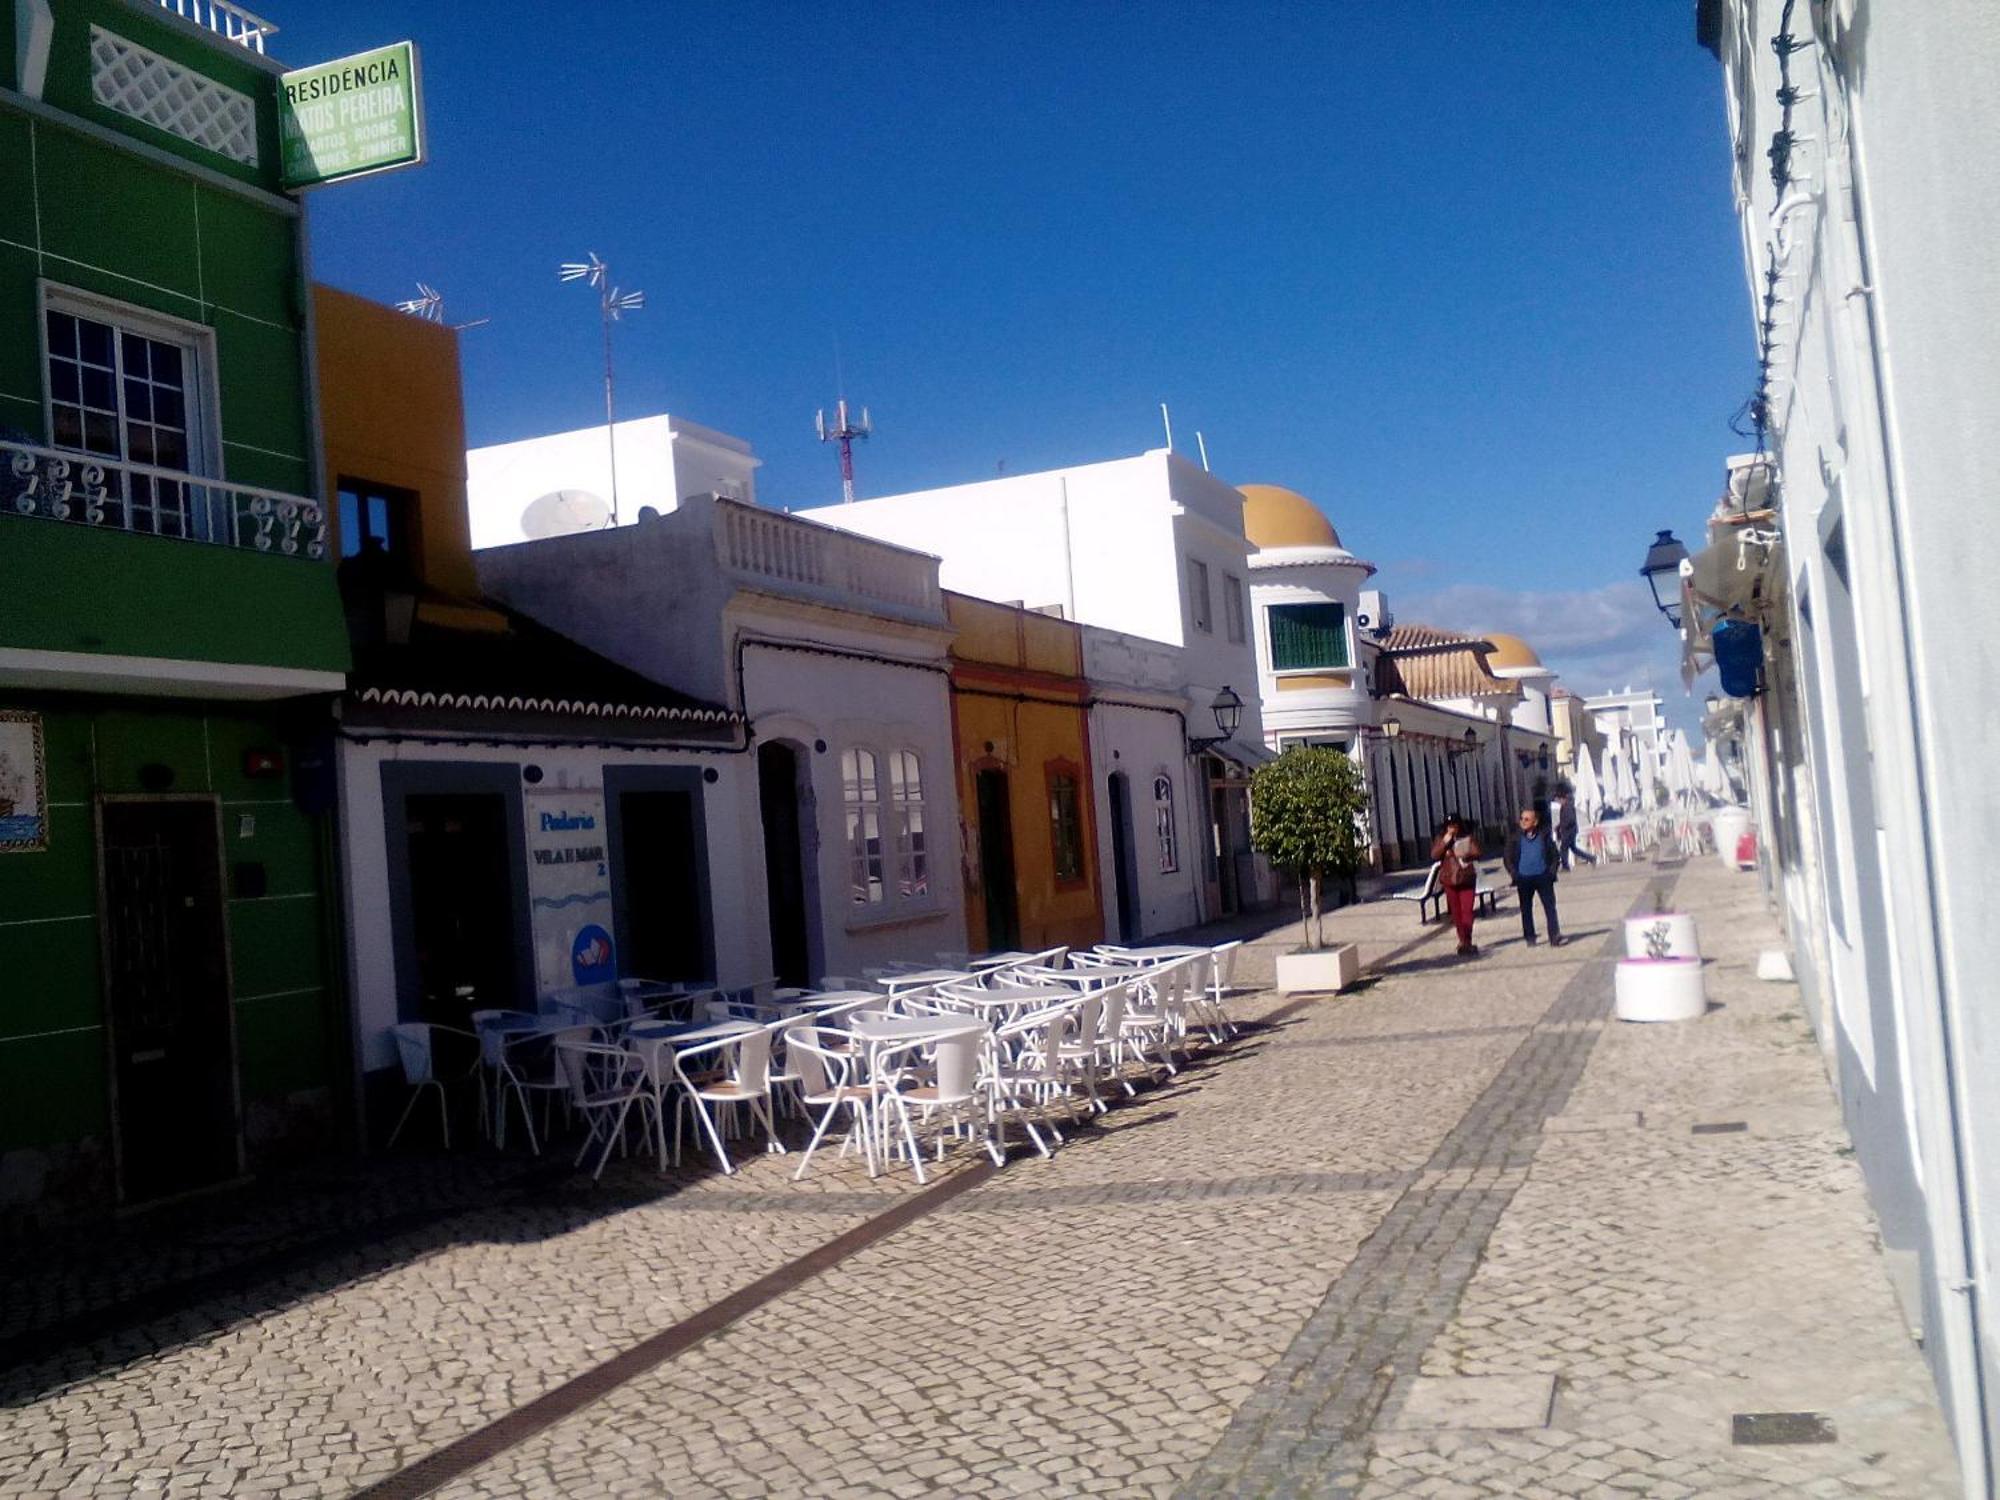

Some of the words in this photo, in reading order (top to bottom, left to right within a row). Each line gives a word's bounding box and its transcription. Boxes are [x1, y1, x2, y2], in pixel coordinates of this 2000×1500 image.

[287, 58, 399, 106] RESIDÊNCIA
[339, 85, 406, 127] PEREIRA
[354, 119, 398, 143] ROOMS
[597, 863, 607, 877] 2
